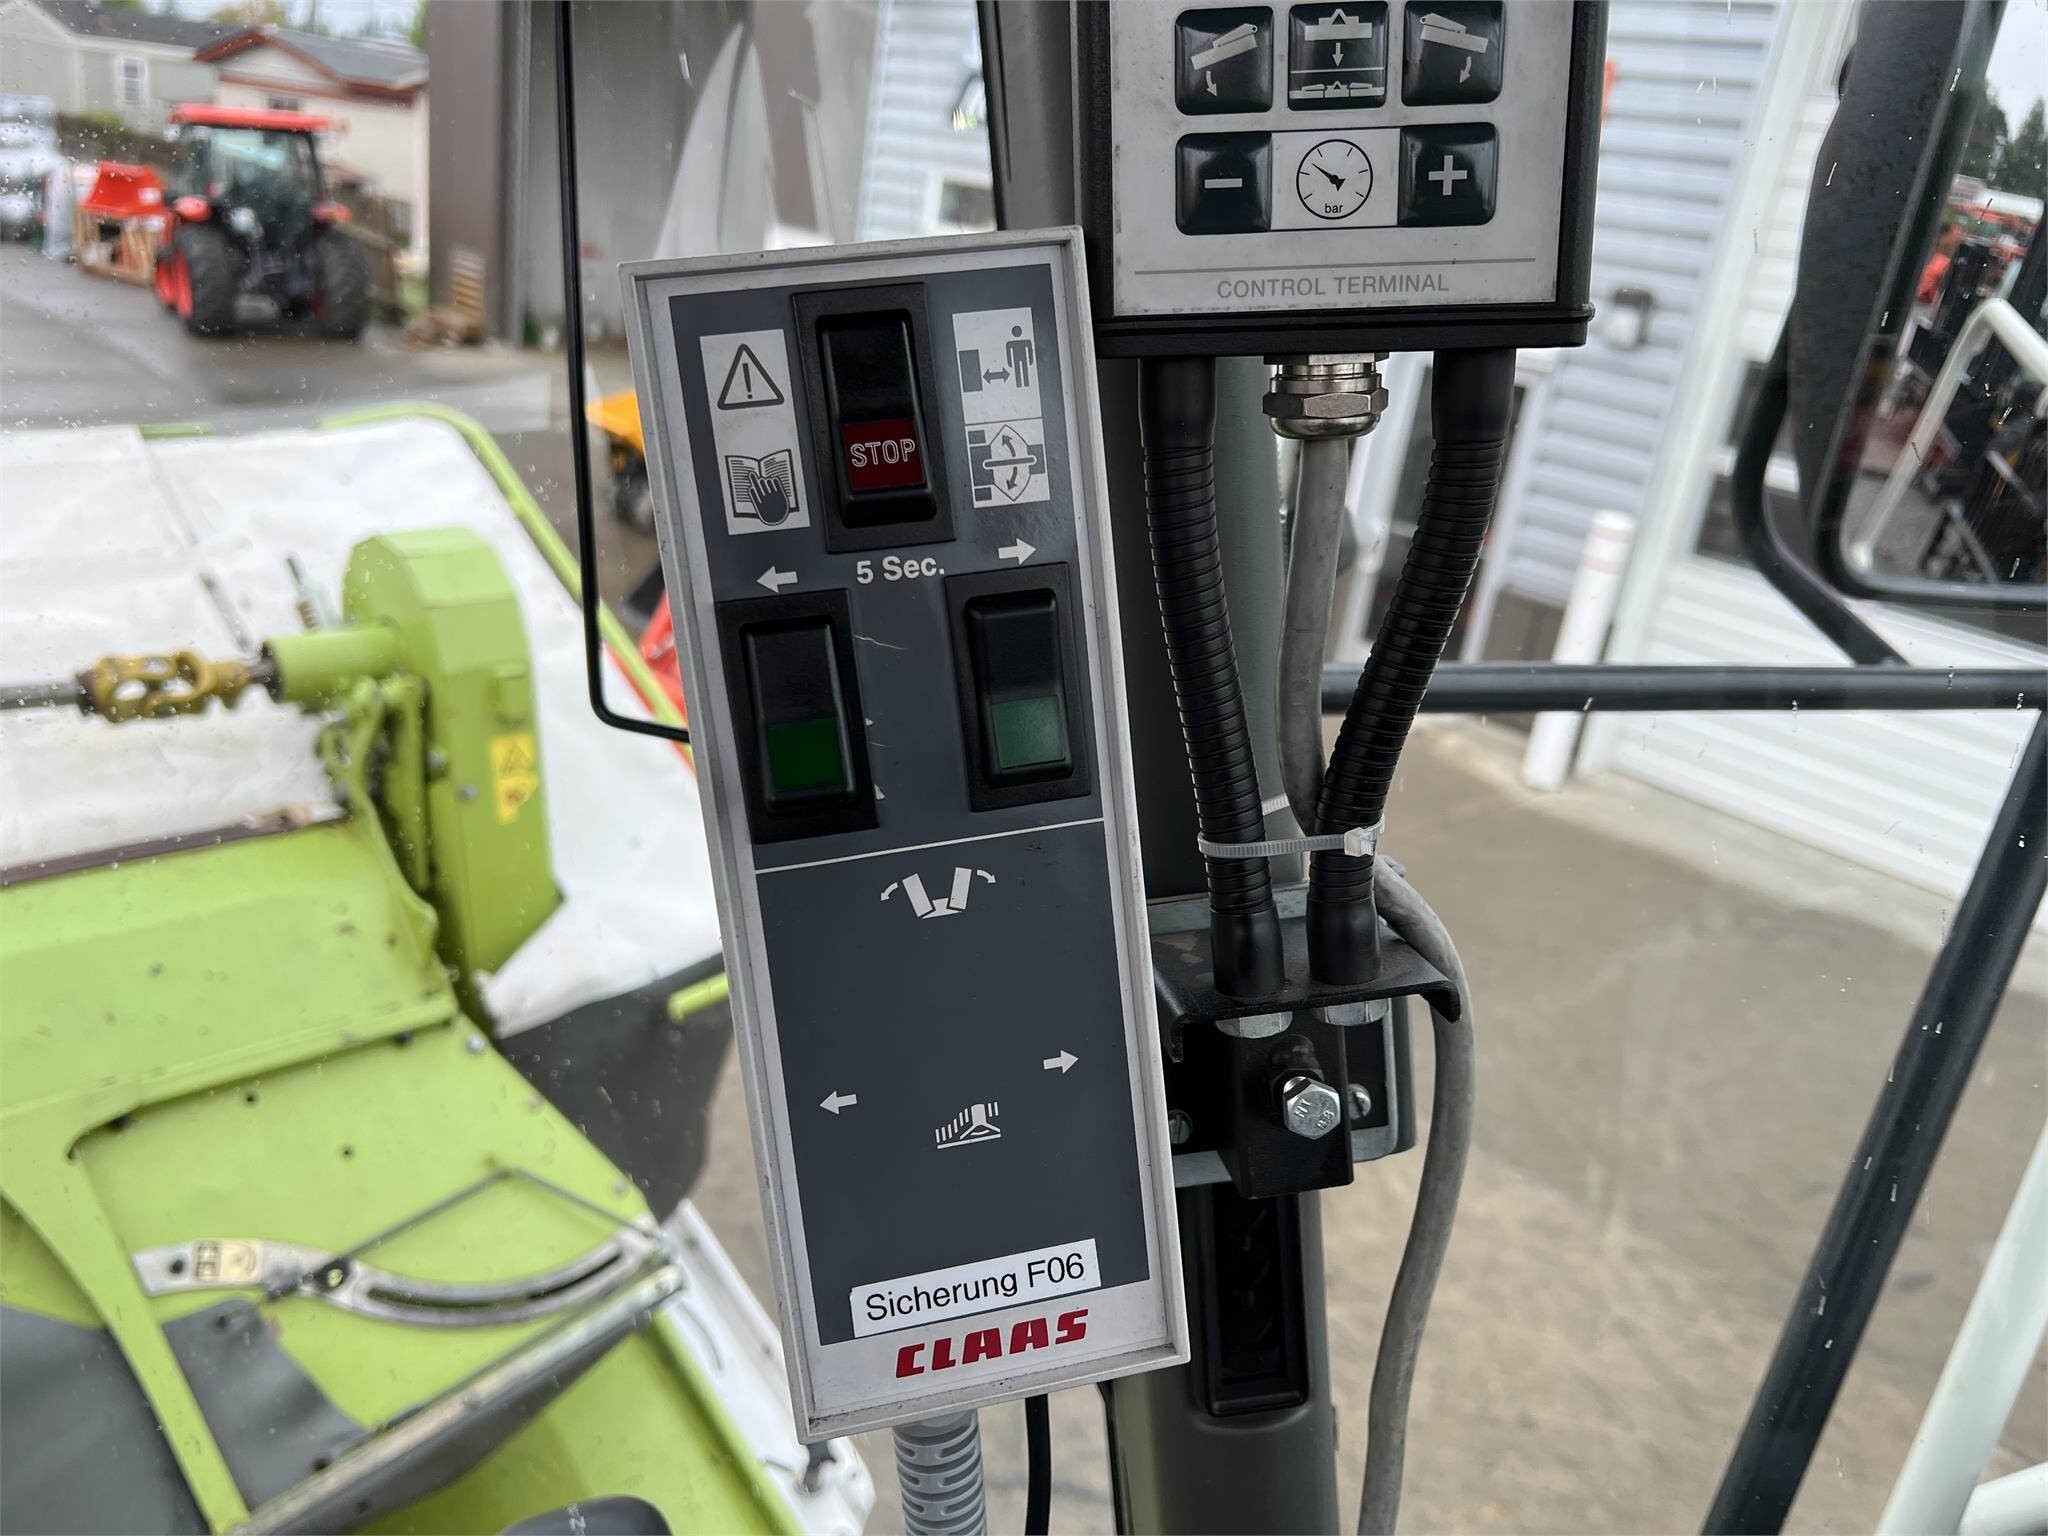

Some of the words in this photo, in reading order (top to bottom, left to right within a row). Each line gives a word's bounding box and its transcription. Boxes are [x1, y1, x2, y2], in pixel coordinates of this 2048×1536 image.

[1324, 203, 1344, 214] bar
[1216, 279, 1327, 300] CONTROL
[1334, 273, 1450, 295] TERMINAL
[850, 439, 916, 467] STOP
[856, 561, 874, 584] 5
[882, 554, 945, 581] Sec.
[866, 1272, 1018, 1321] Sicherung
[1027, 1252, 1085, 1288] F06
[895, 1309, 1088, 1378] CLAAS
